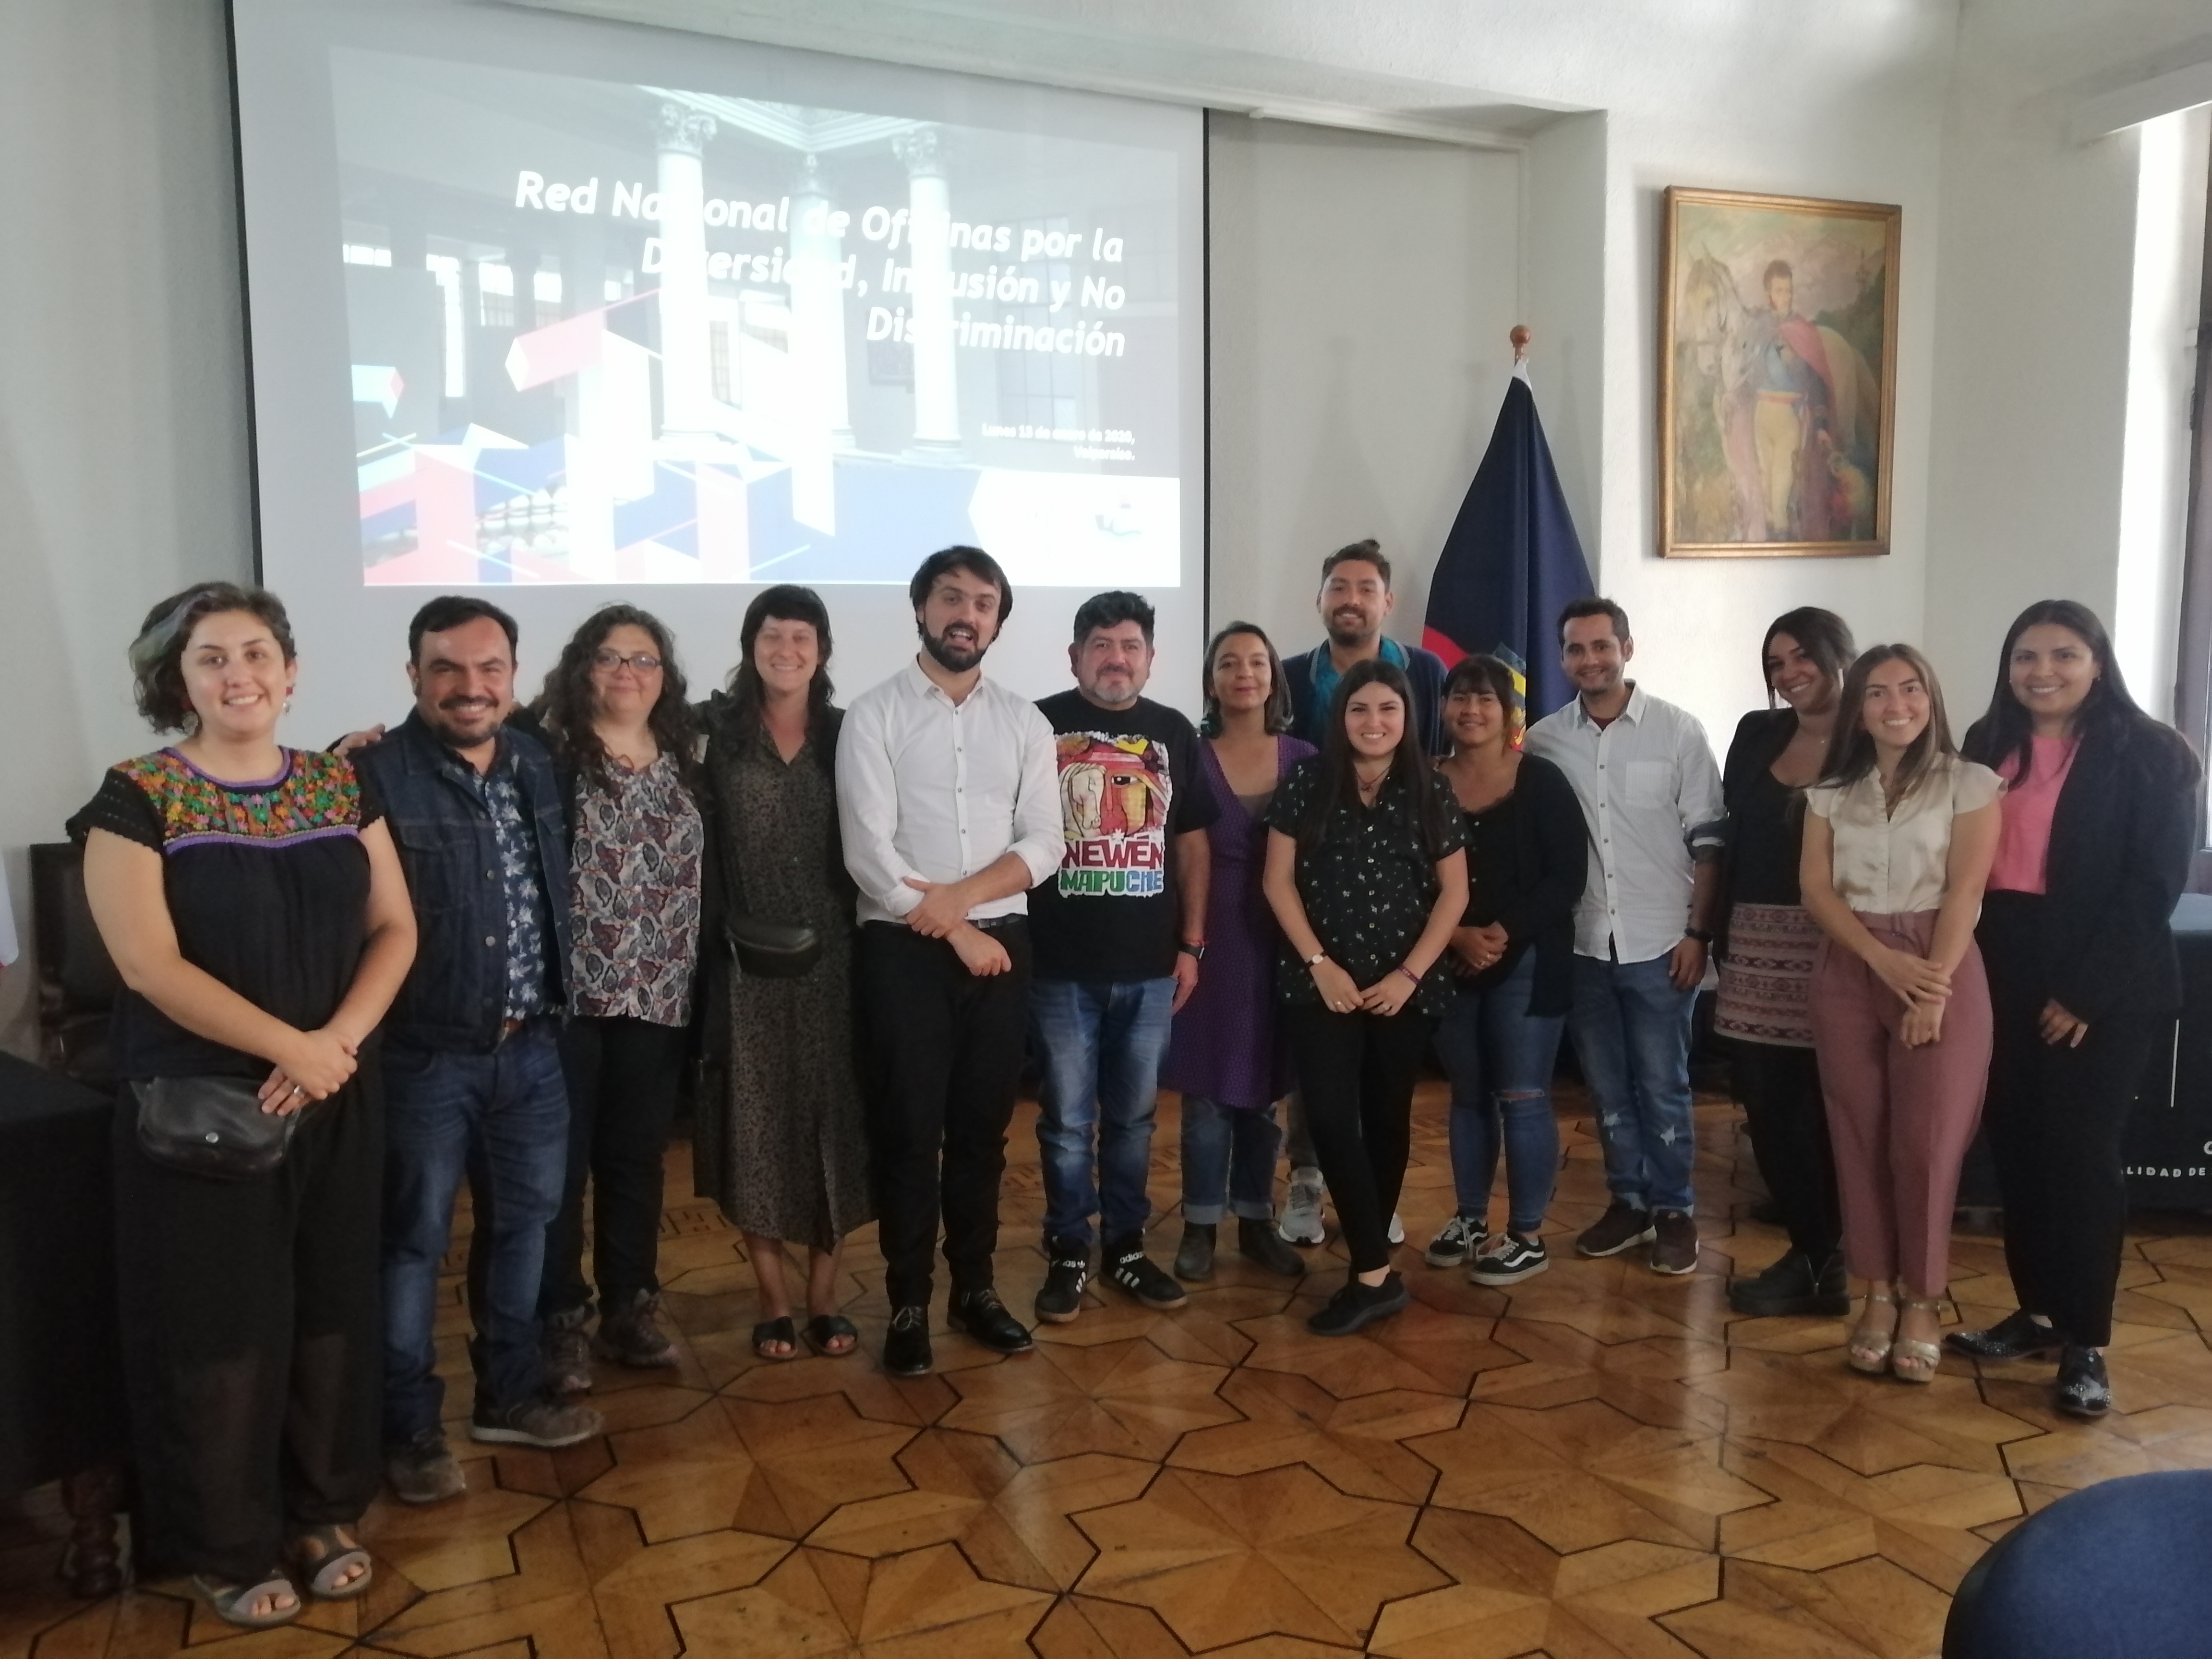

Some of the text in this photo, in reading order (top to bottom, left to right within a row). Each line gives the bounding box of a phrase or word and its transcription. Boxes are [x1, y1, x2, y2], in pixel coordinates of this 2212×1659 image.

[515, 170, 1124, 262] Red Naonal de Ofinas por la
[641, 237, 1125, 312] Dersidd, Inusión y No
[866, 306, 1125, 357] Disiminación
[982, 422, 1016, 437] Lunes
[1035, 425, 1050, 439] de
[1088, 428, 1103, 442] de
[1105, 429, 1135, 445] 2020,
[1061, 839, 1163, 869] NEWEN
[1060, 870, 1163, 892] MAPUCHE
[2121, 1166, 2206, 1178] LIDAD DE
[1119, 1251, 1144, 1264] adida
